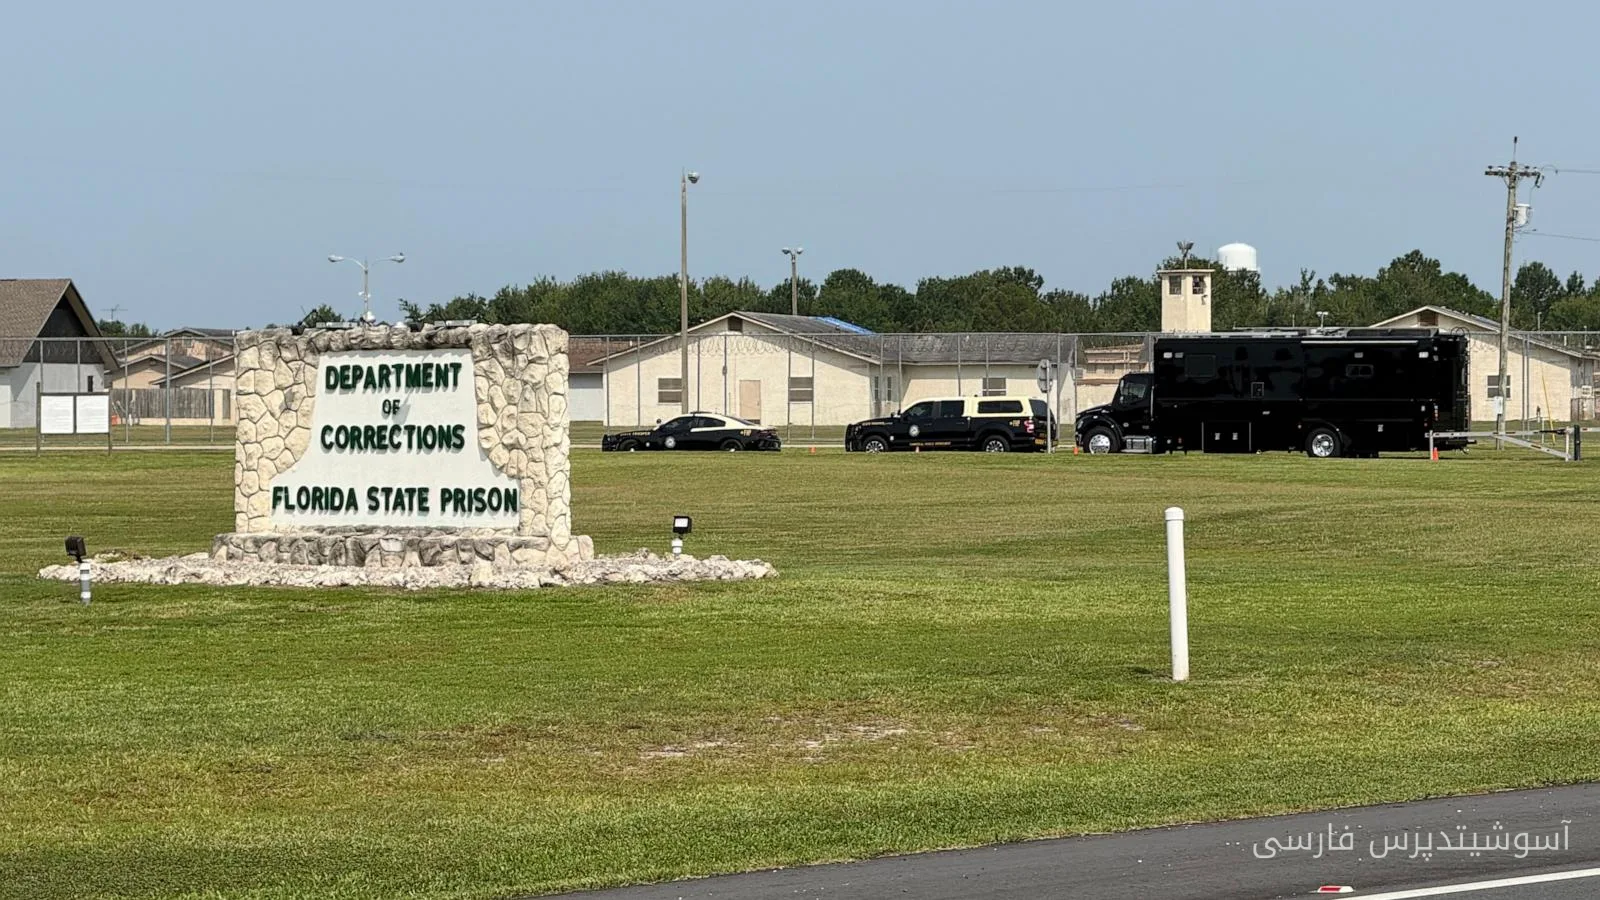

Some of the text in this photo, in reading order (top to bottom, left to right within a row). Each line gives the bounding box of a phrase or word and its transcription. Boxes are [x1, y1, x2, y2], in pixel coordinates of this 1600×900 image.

[325, 362, 462, 391] DEPARTMENT
[382, 399, 401, 416] OF
[320, 424, 465, 451] CORRECTIONS
[272, 486, 518, 514] FLORIDA STATE PRISON
